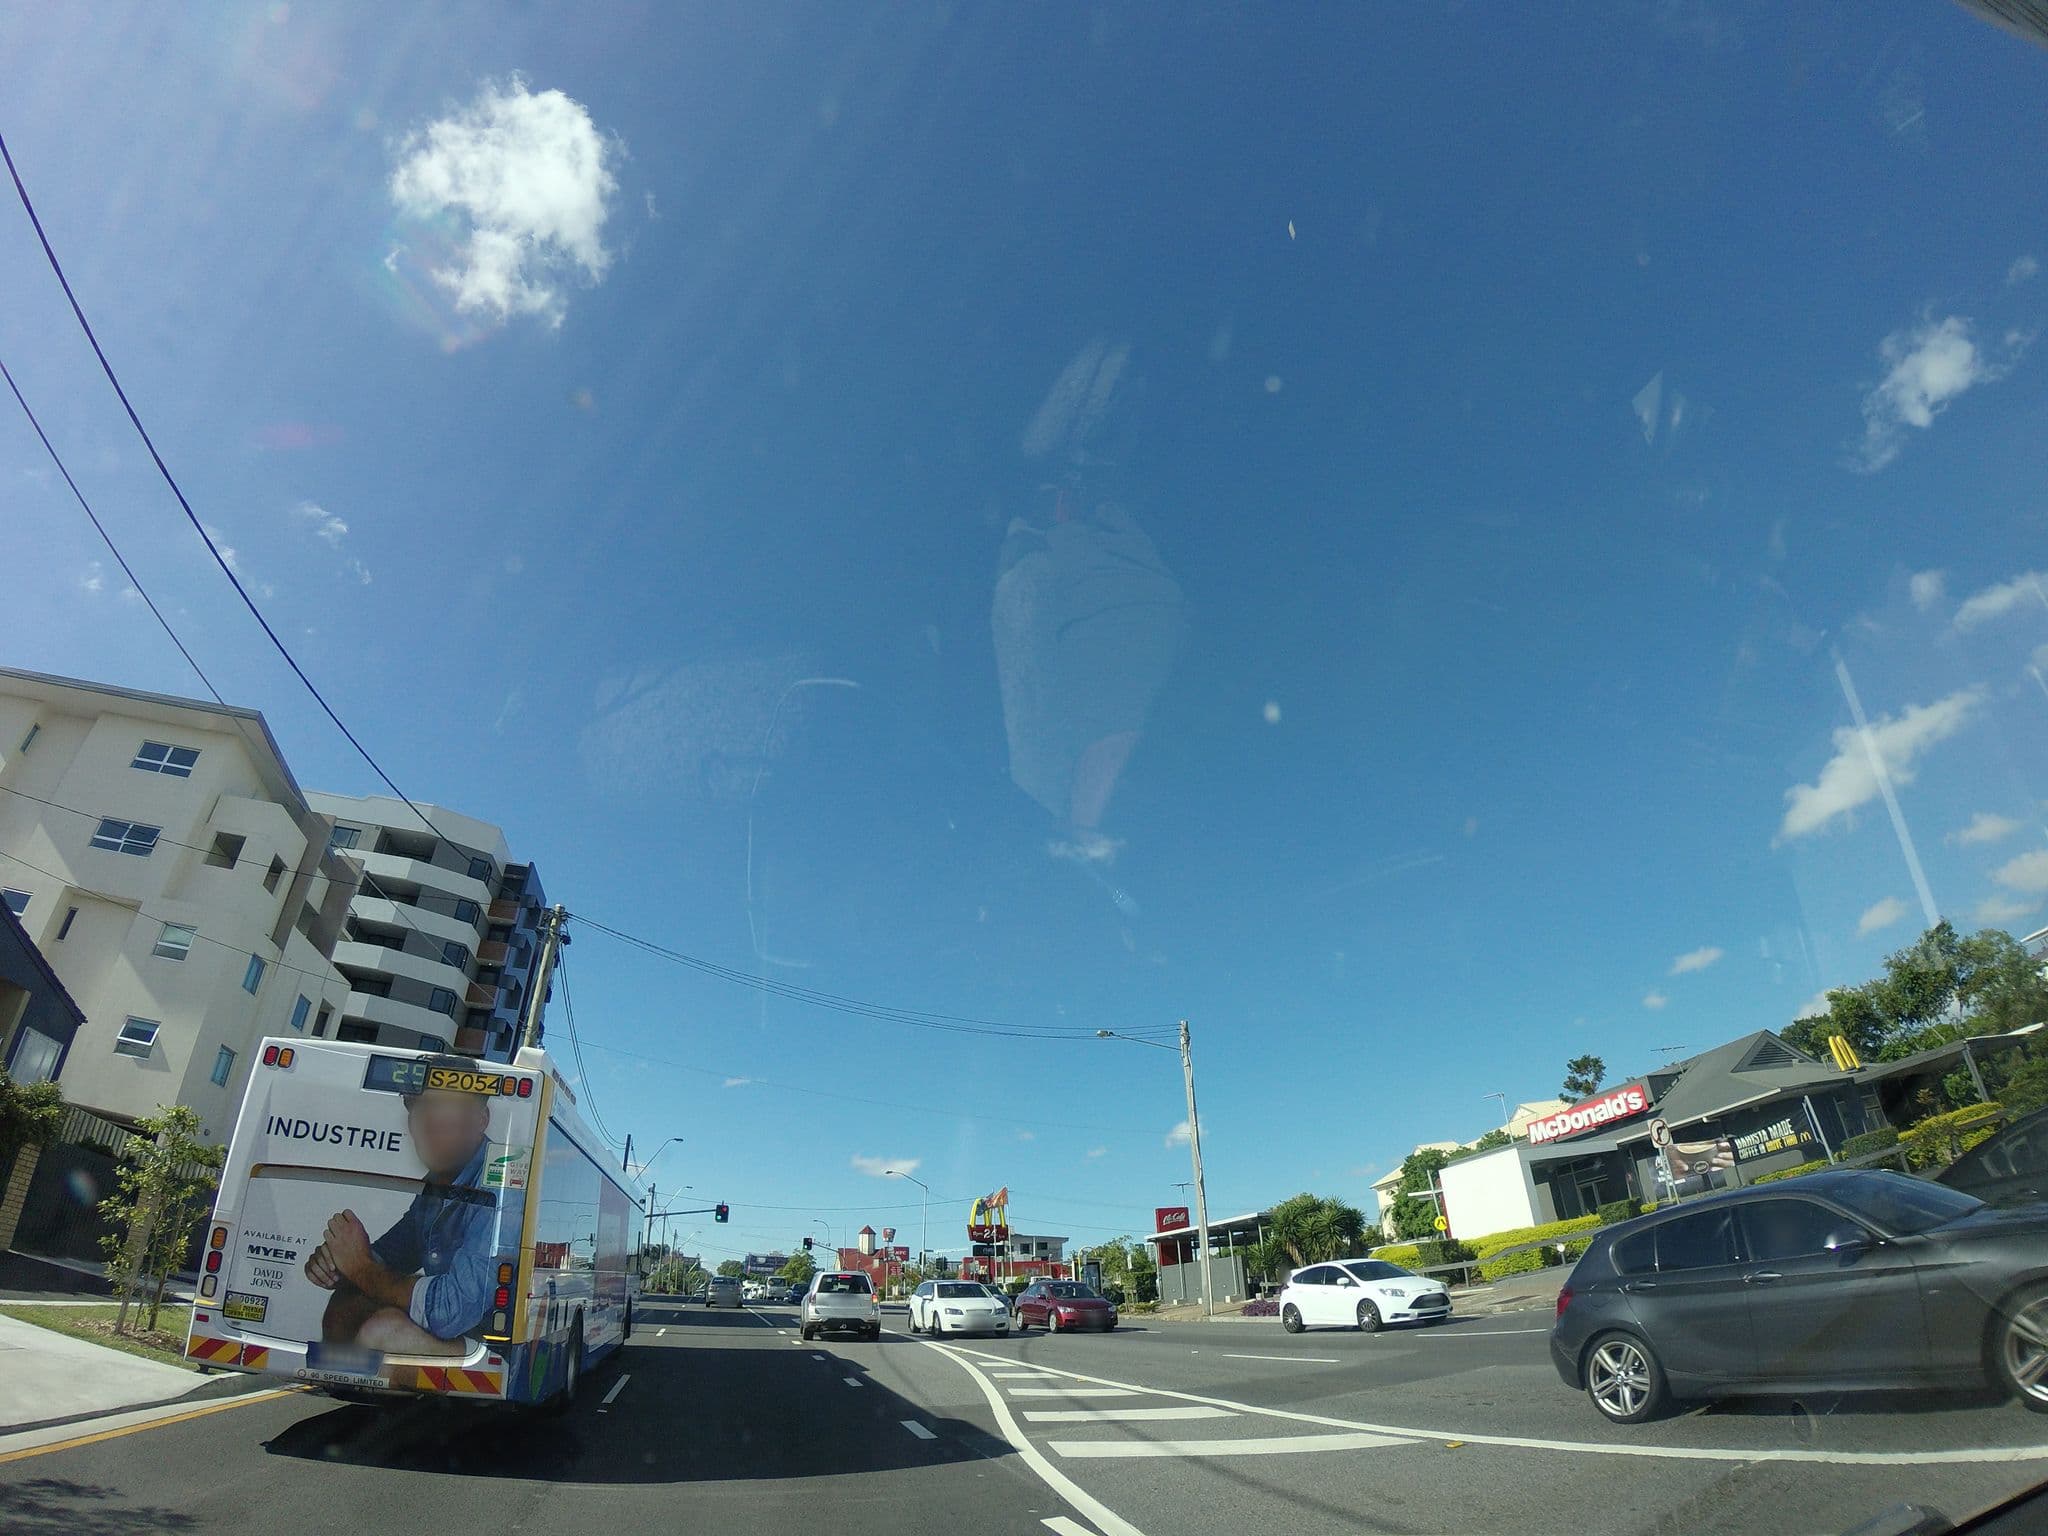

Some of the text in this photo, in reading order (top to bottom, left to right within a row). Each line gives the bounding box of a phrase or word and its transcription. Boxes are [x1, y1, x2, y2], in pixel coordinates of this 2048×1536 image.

[431, 1071, 500, 1093] S2054
[1529, 1091, 1643, 1144] McDonald's
[266, 1115, 402, 1152] INDUSTRIE
[1767, 1118, 1795, 1139] MADE
[1738, 1144, 1760, 1160] COFFEE
[244, 1229, 308, 1246] AVAILABLE AT
[247, 1244, 297, 1261] MYER
[253, 1267, 284, 1280] DAVID
[250, 1277, 282, 1290] JONES
[323, 1373, 349, 1383] SPEED
[353, 1376, 384, 1387] LIMITED
